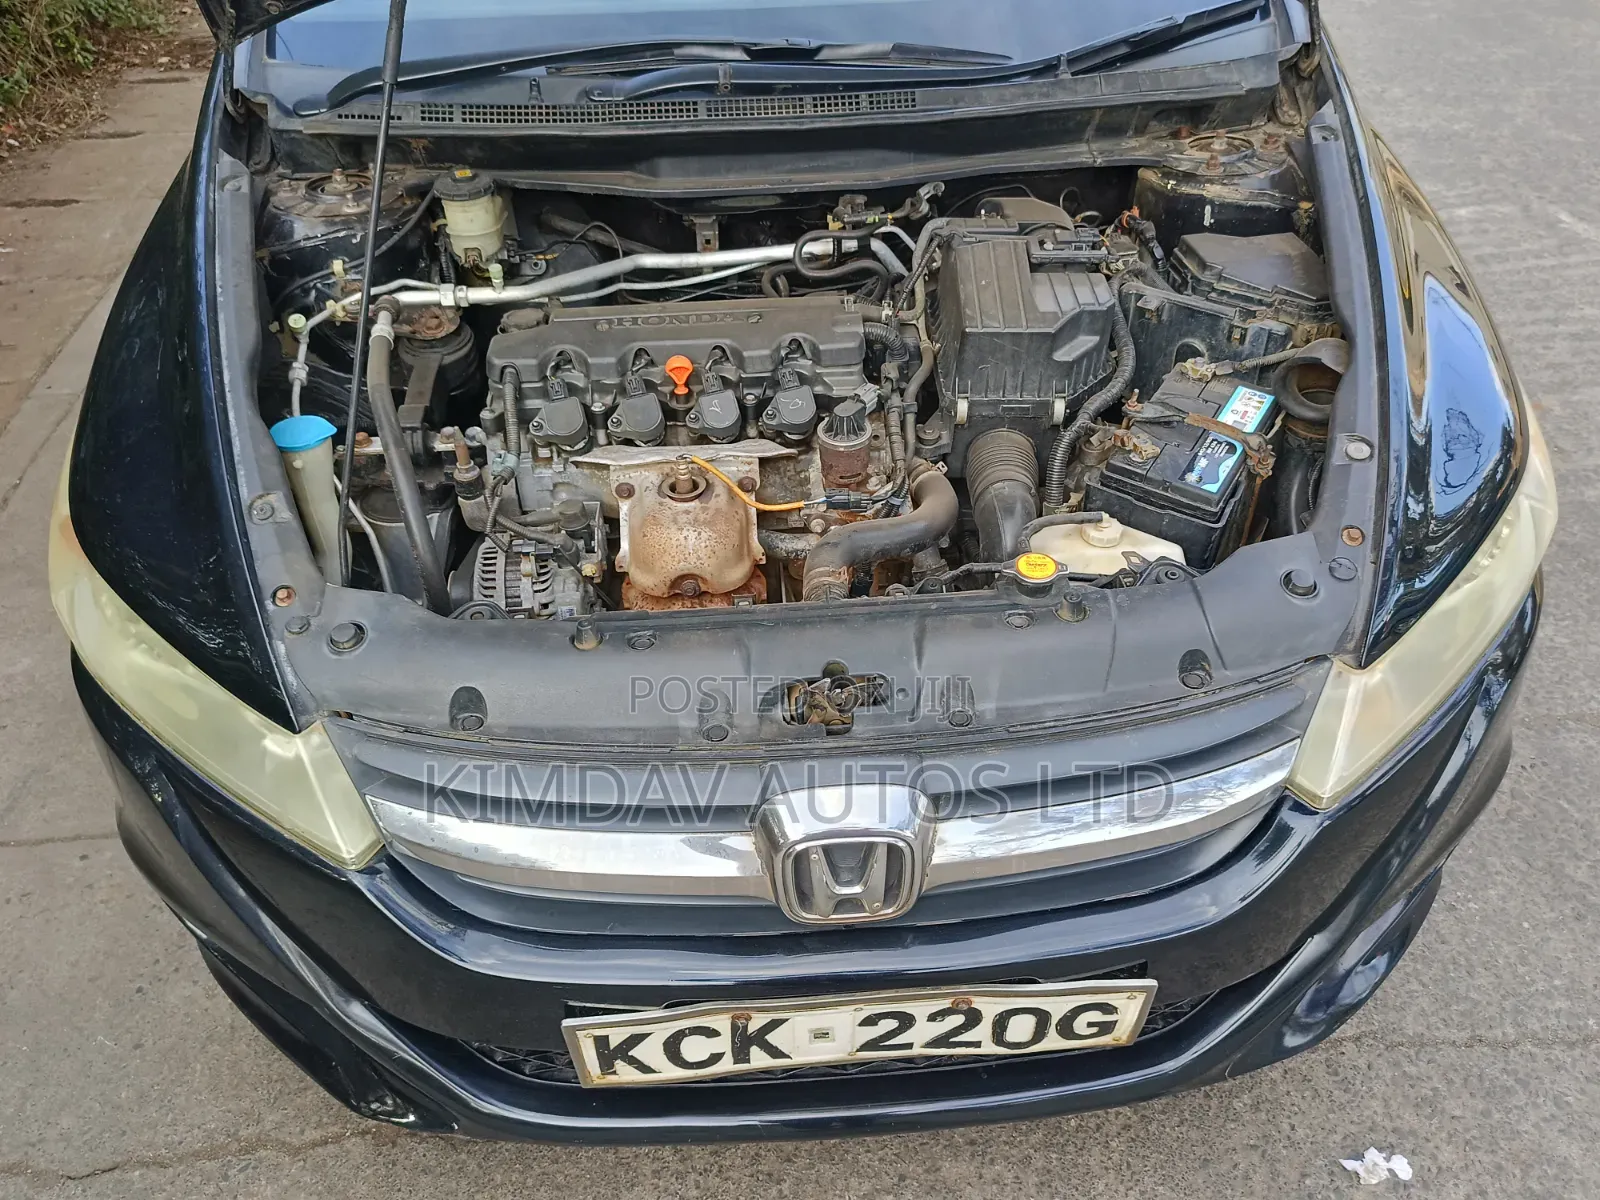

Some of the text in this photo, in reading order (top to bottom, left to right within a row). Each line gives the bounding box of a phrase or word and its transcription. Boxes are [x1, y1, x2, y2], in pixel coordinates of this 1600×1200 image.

[613, 313, 746, 329] HONDA
[593, 1002, 1120, 1076] KCK 220G
